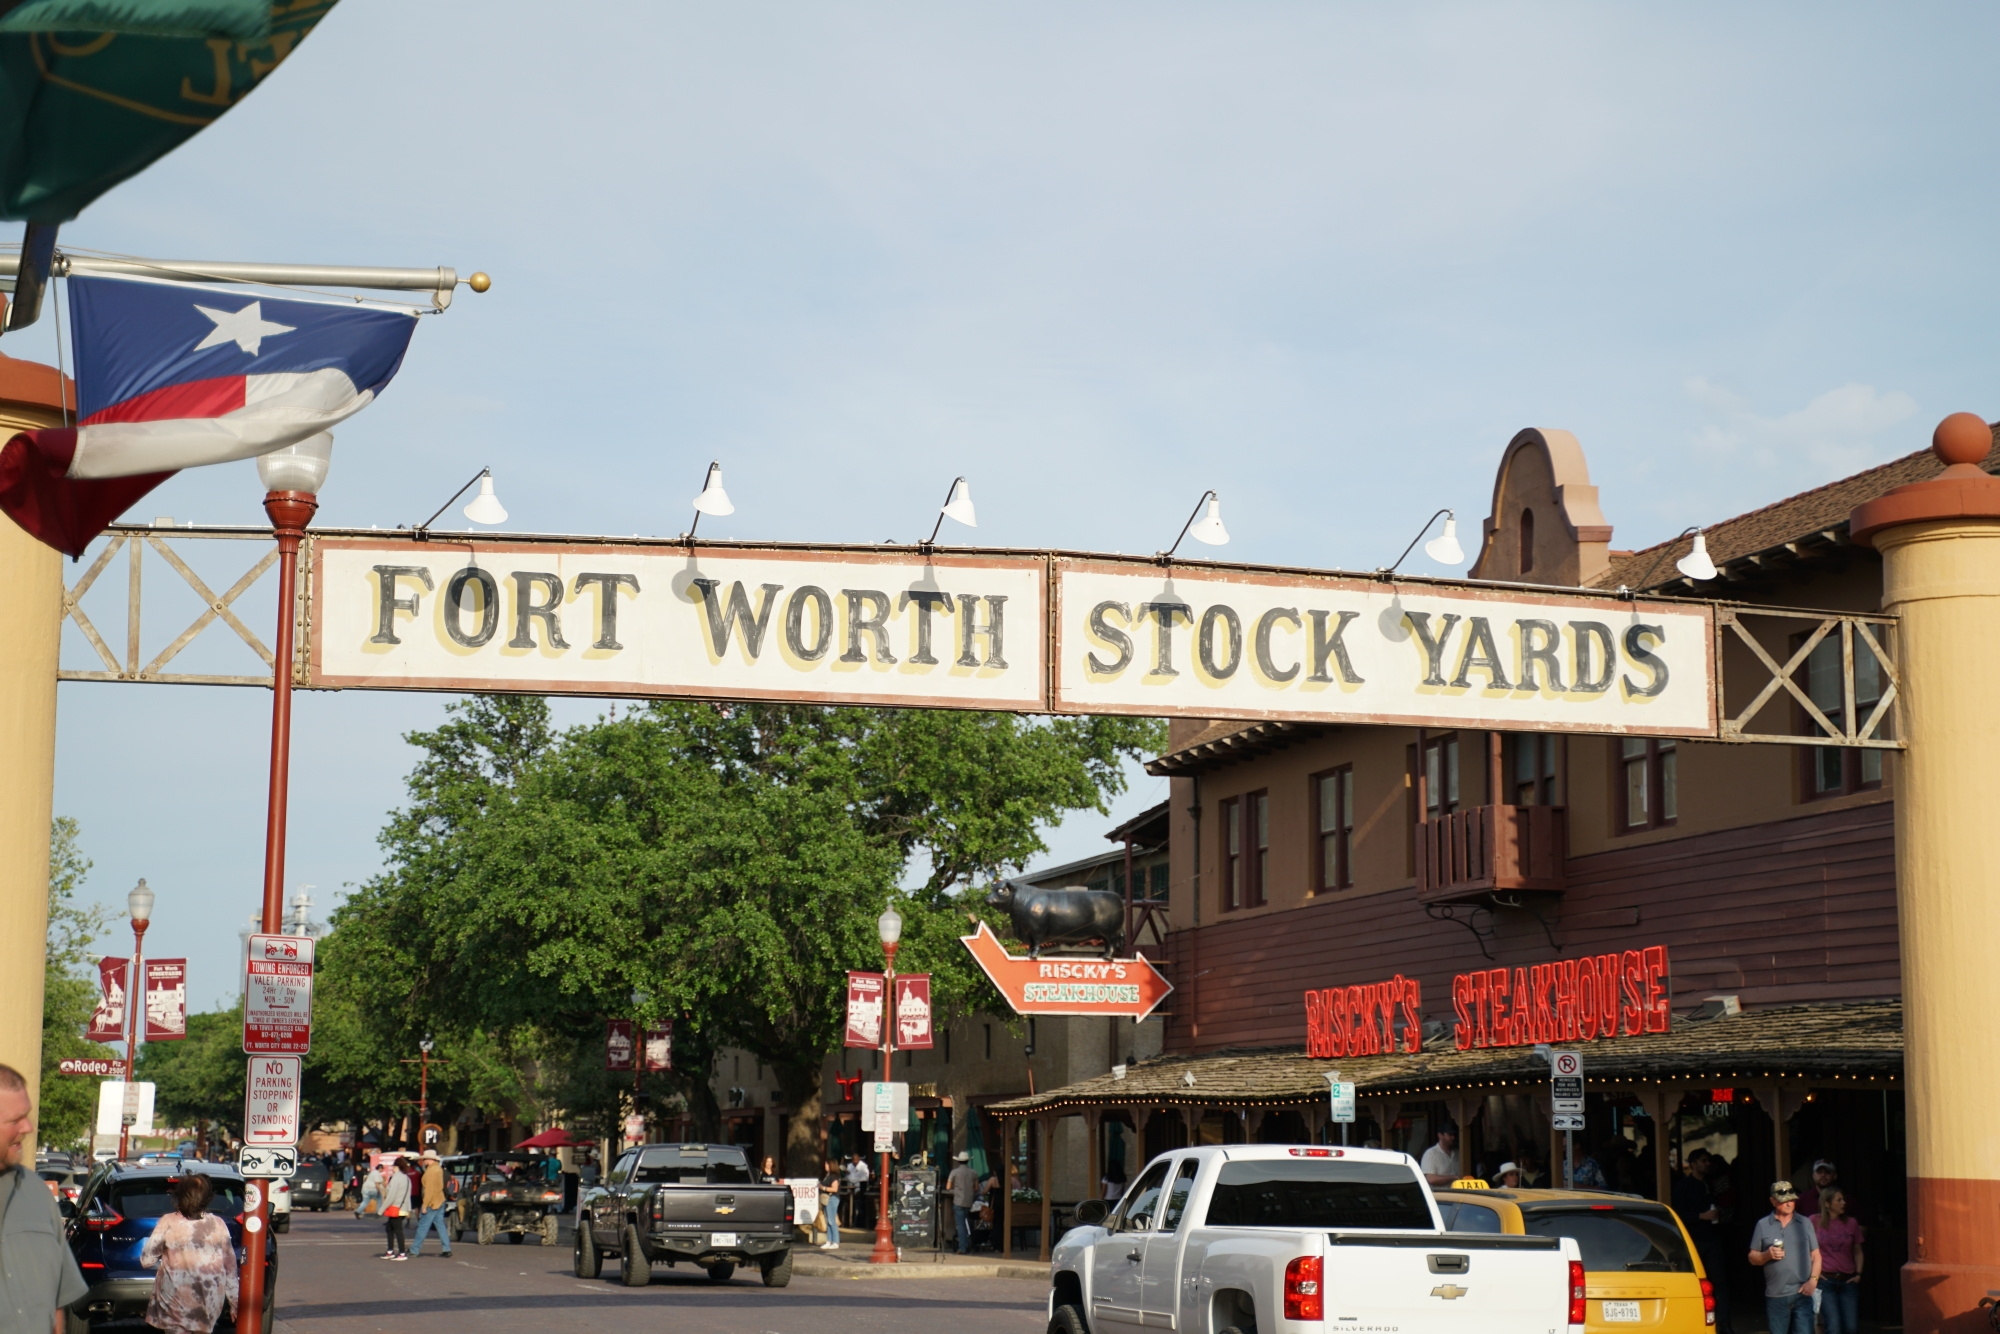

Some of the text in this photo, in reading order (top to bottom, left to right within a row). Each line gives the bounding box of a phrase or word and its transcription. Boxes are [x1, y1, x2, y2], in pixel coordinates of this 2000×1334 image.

[368, 564, 1670, 698] FORT WORTH STOCK YARDS
[251, 962, 309, 975] TOWING ENFORCED
[1039, 963, 1127, 979] RISCKY'S
[254, 975, 306, 988] VALET PARKING
[286, 988, 297, 997] Day
[1024, 983, 1140, 1003] STEAKHOUSE
[1452, 944, 1670, 1051] STEAKHOUSE
[283, 996, 295, 1004] SUN
[248, 1009, 275, 1017] UNAUTHORIZED
[1305, 973, 1421, 1059] RISCKY'S
[74, 1060, 107, 1073] Rodeo
[265, 1062, 283, 1075] NO
[255, 1077, 292, 1088] PARKING
[253, 1090, 294, 1100] STOPPING
[266, 1102, 279, 1112] OR
[1703, 1102, 1730, 1117] OPEN
[251, 1115, 293, 1125] STANDING
[1460, 1181, 1484, 1189] TAXI
[792, 1186, 816, 1199] OURS
